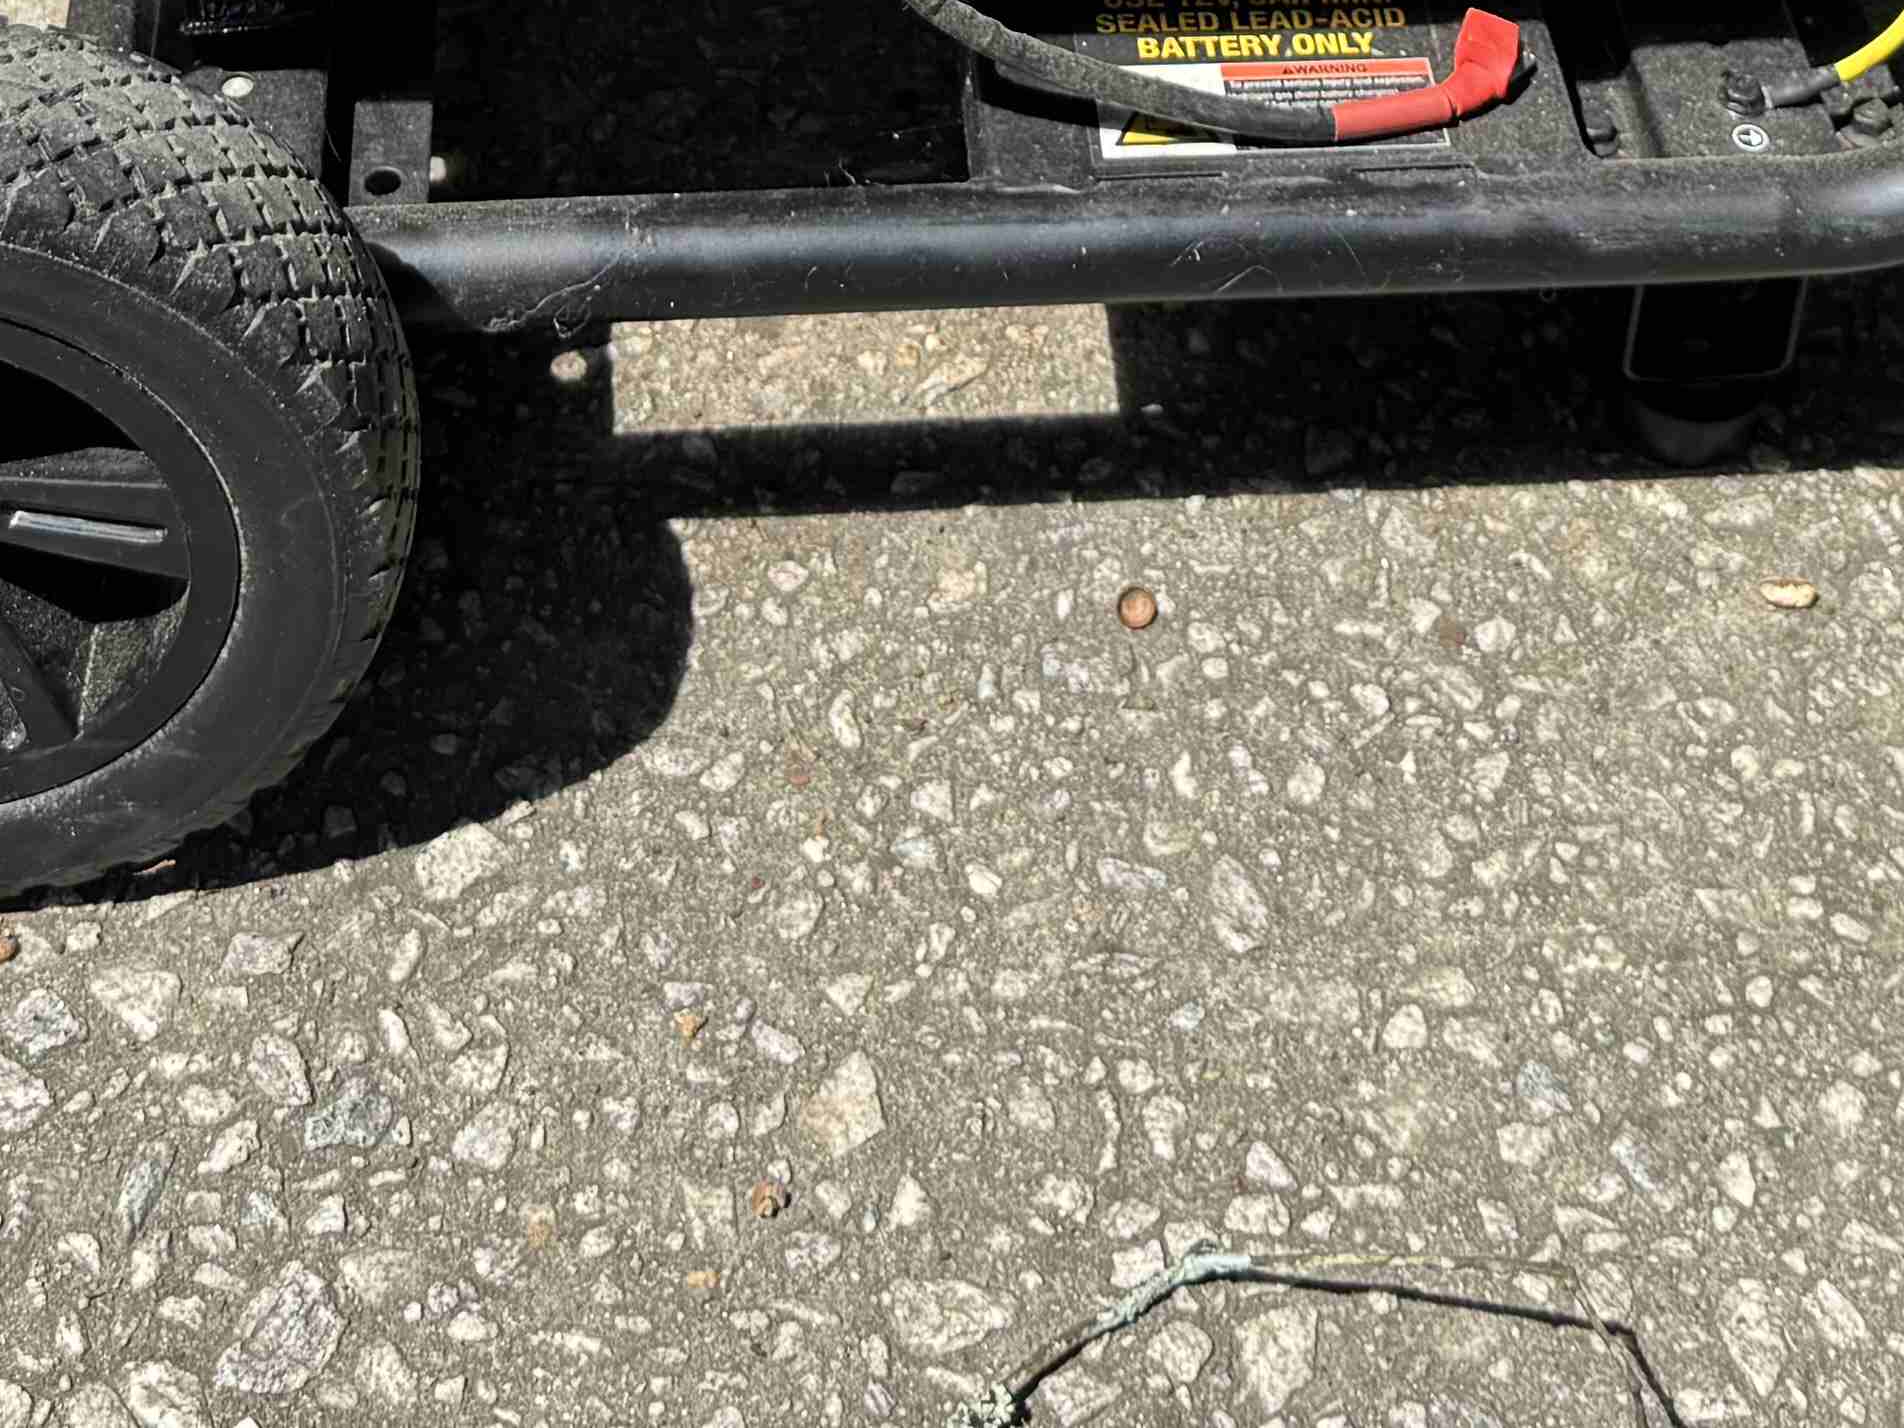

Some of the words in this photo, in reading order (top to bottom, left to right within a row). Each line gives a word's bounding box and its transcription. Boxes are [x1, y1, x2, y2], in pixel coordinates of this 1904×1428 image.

[1095, 10, 1219, 34] SEALED
[1231, 7, 1407, 31] LEAD-ACID
[1136, 34, 1283, 59] BATTERY
[1290, 31, 1376, 57] ONLY
[1294, 62, 1368, 75] WARNING
